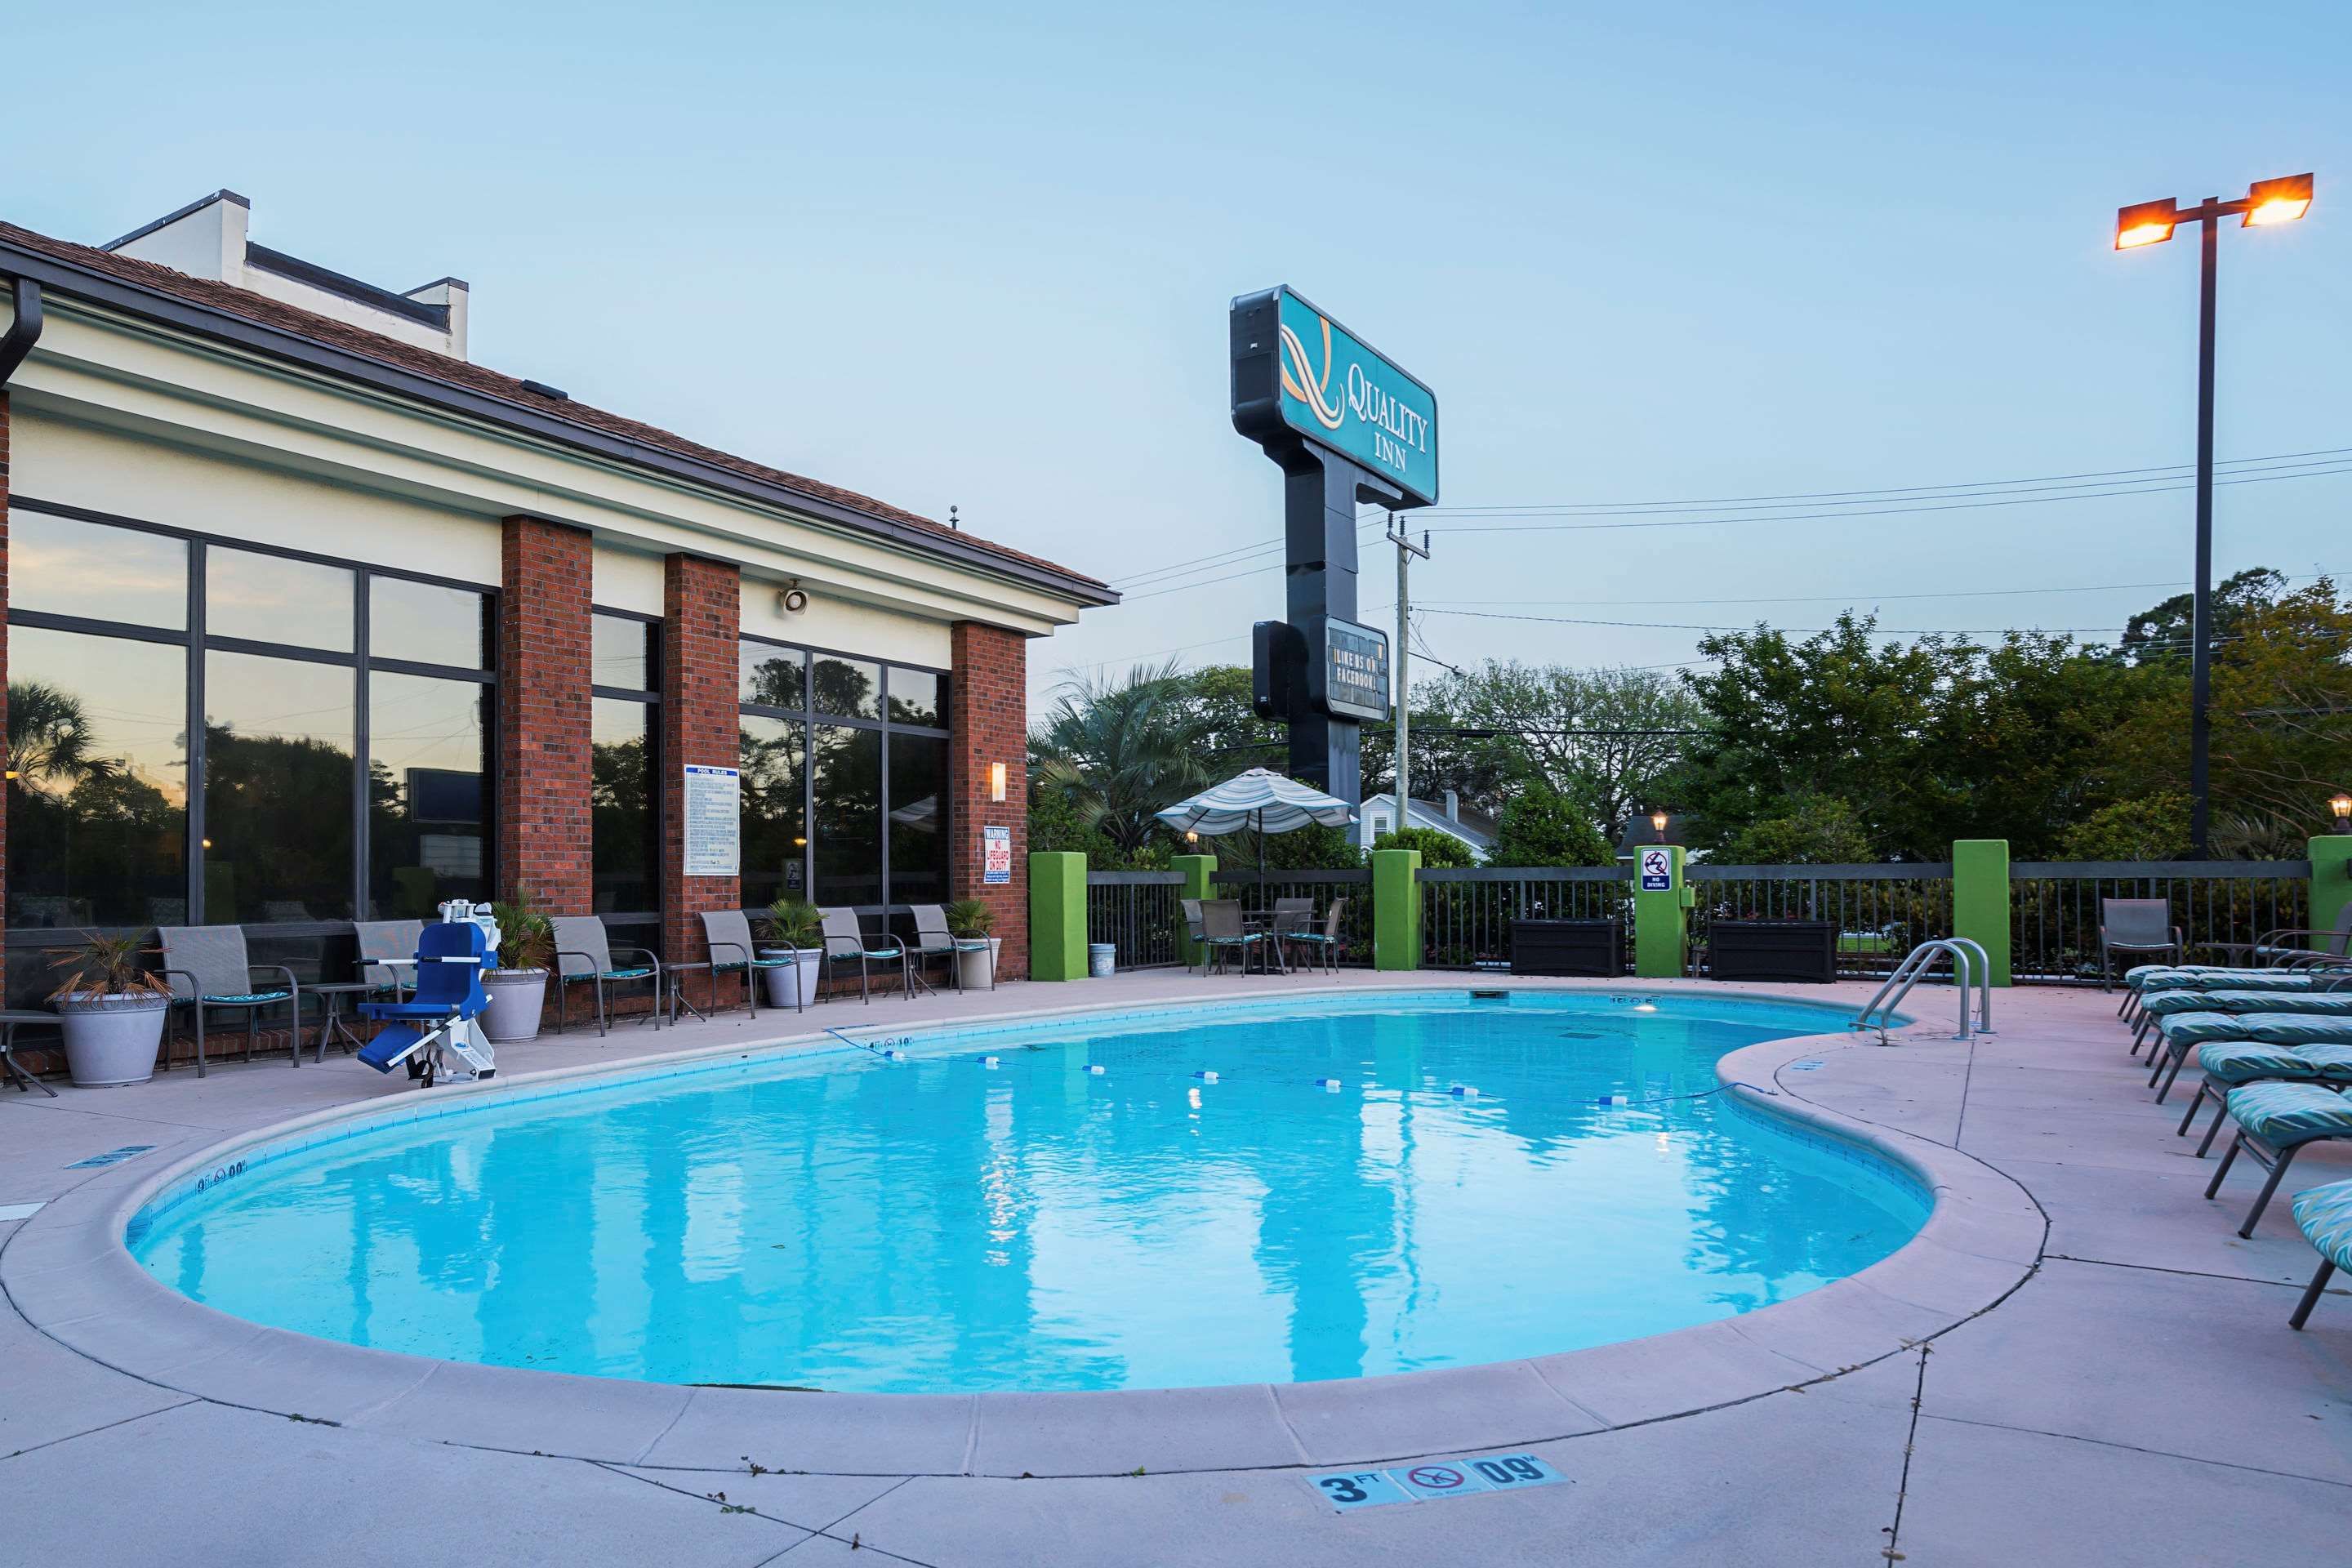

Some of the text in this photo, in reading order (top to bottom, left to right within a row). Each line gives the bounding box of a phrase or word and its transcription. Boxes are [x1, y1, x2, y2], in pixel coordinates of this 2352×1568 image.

[1348, 363, 1428, 453] QUALITY
[1374, 431, 1406, 473] INN
[1355, 653, 1363, 670] US
[1366, 657, 1376, 673] ON
[1337, 666, 1376, 691] FACEBOOK!
[986, 829, 1009, 840] WARNING
[995, 840, 1001, 849] NO
[987, 850, 1009, 860] LIFEGUARD
[989, 861, 1006, 871] ON DUTY
